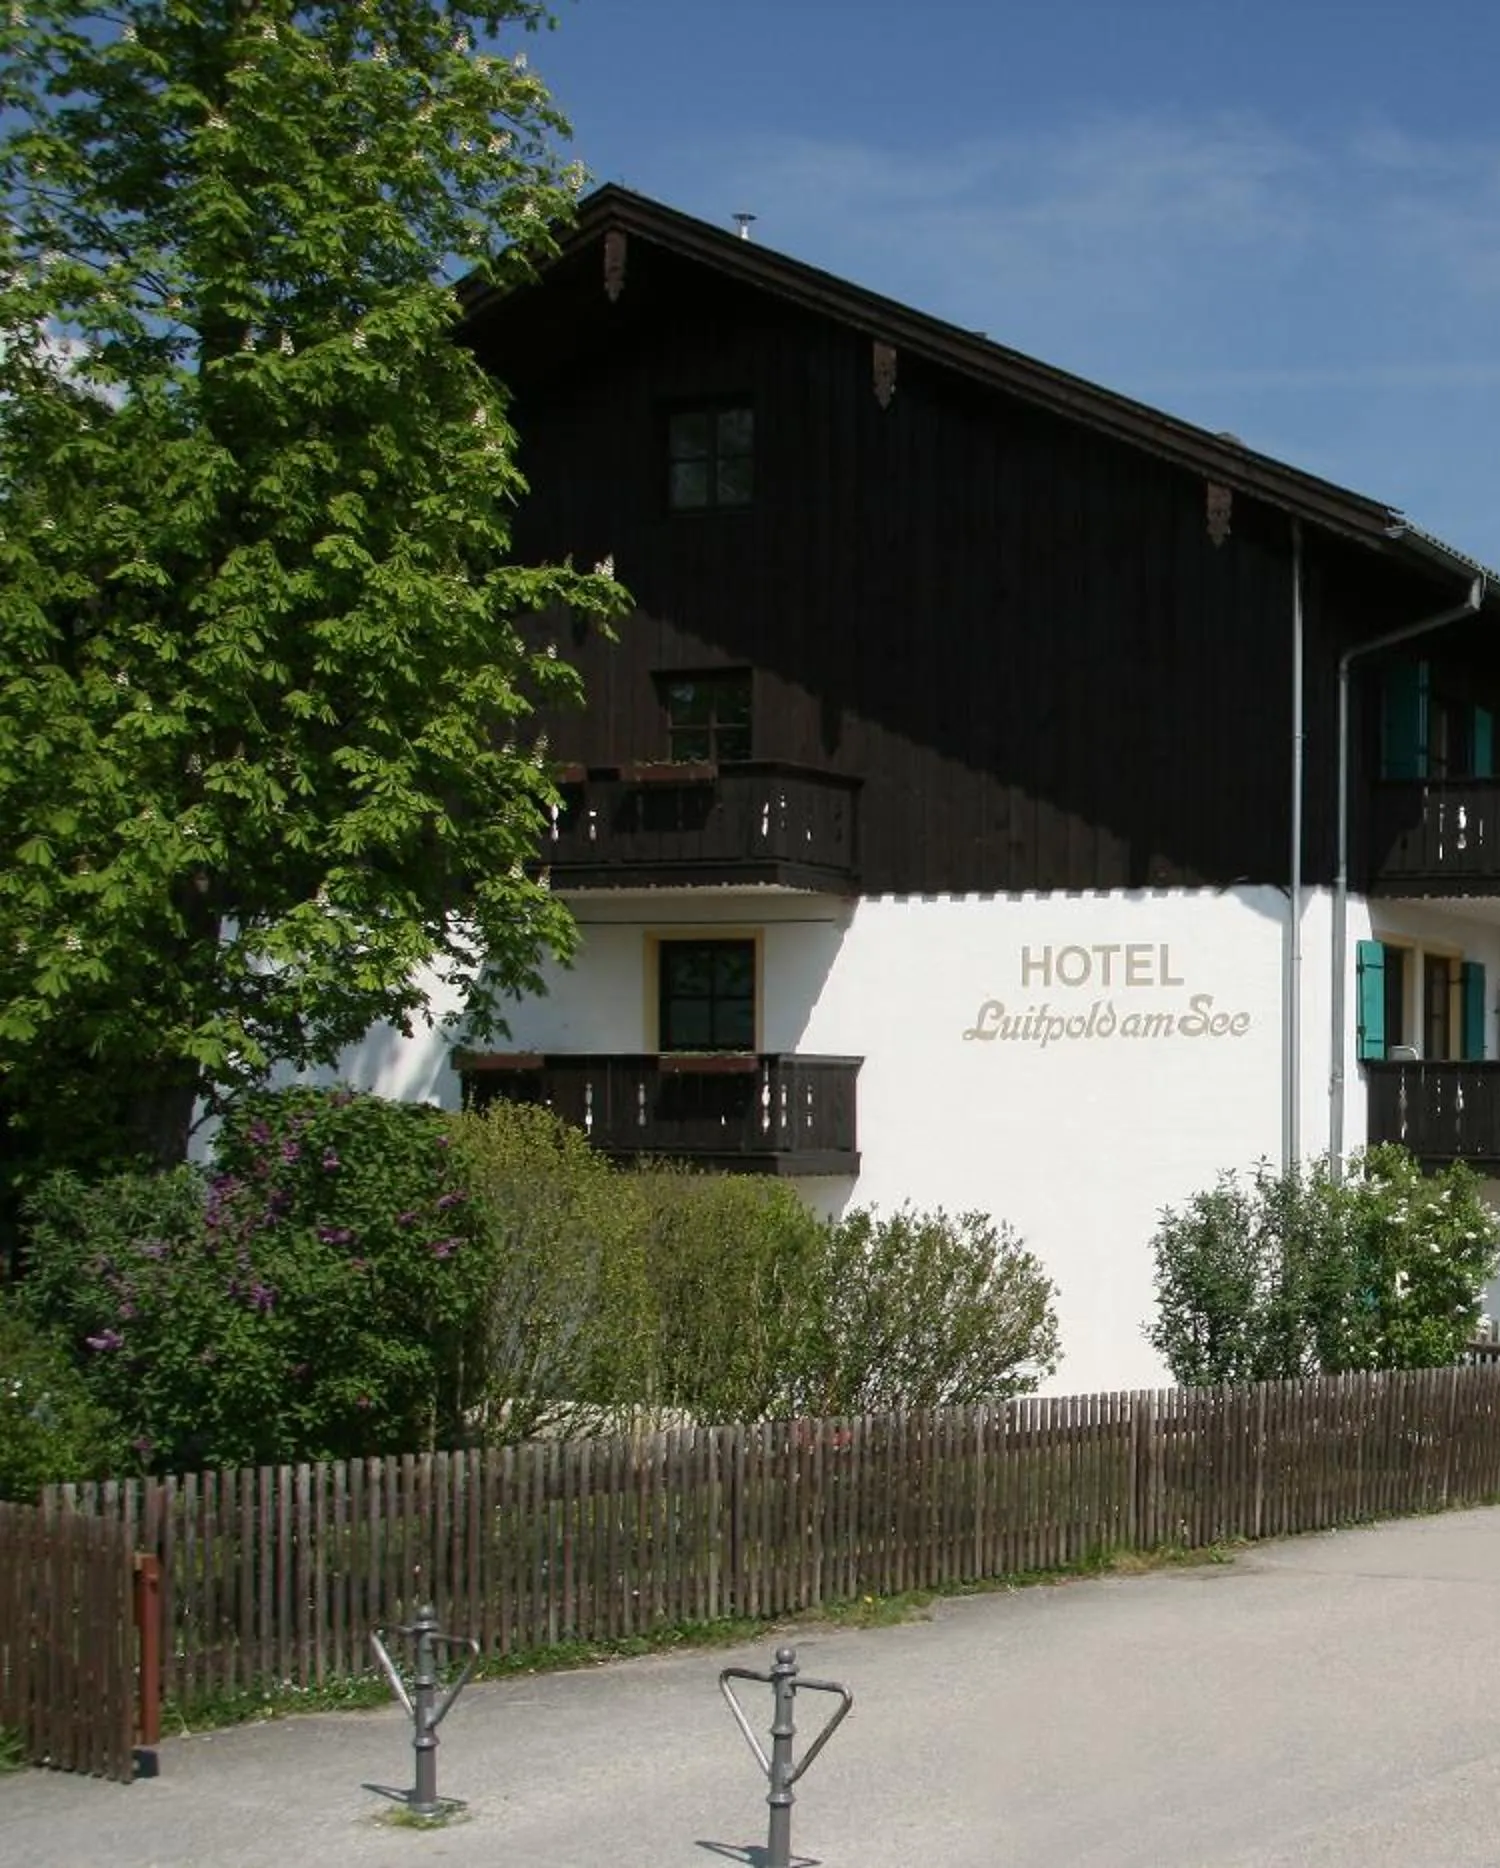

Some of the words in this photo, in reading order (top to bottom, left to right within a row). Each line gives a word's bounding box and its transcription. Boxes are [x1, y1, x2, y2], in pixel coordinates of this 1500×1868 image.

[1021, 943, 1184, 987] HOTEL
[962, 1000, 1117, 1048] Luitpold
[1119, 1012, 1175, 1038] am
[1177, 993, 1251, 1037] See
